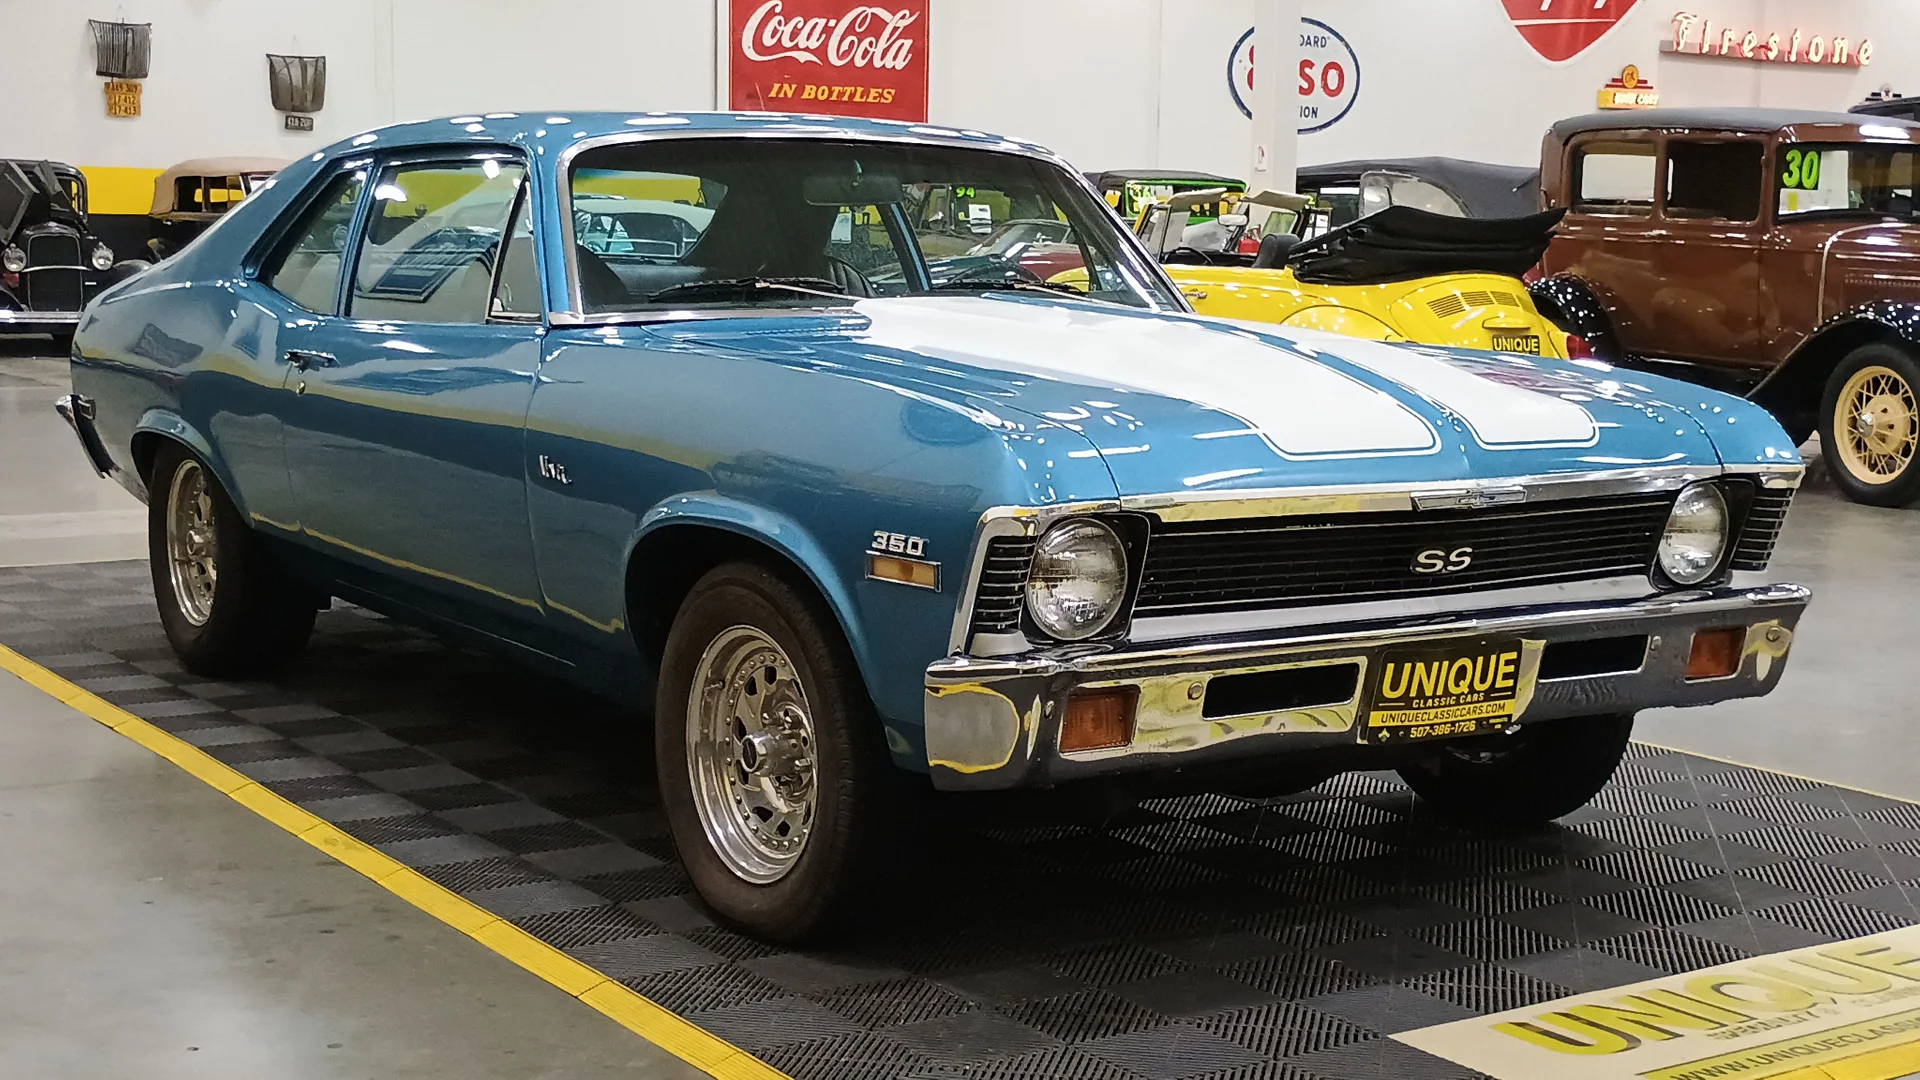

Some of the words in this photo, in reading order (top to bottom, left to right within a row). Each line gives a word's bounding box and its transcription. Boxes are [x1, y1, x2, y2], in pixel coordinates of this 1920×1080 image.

[742, 0, 921, 70] Coca-Cola
[1671, 11, 1873, 66] Firestone
[768, 82, 797, 98] IN
[801, 84, 896, 104] BOTTLES
[1782, 149, 1819, 190] 30
[1493, 336, 1540, 352] UNIQUE
[871, 529, 925, 556] 350
[1414, 547, 1474, 573] SS
[1382, 651, 1518, 699] UNIQUE
[1380, 702, 1506, 724] UNIQUECLASSICCARS.COM
[1412, 695, 1456, 709] CLASSIC
[1459, 692, 1485, 704] CARS
[1409, 720, 1476, 739] 507-386-1726
